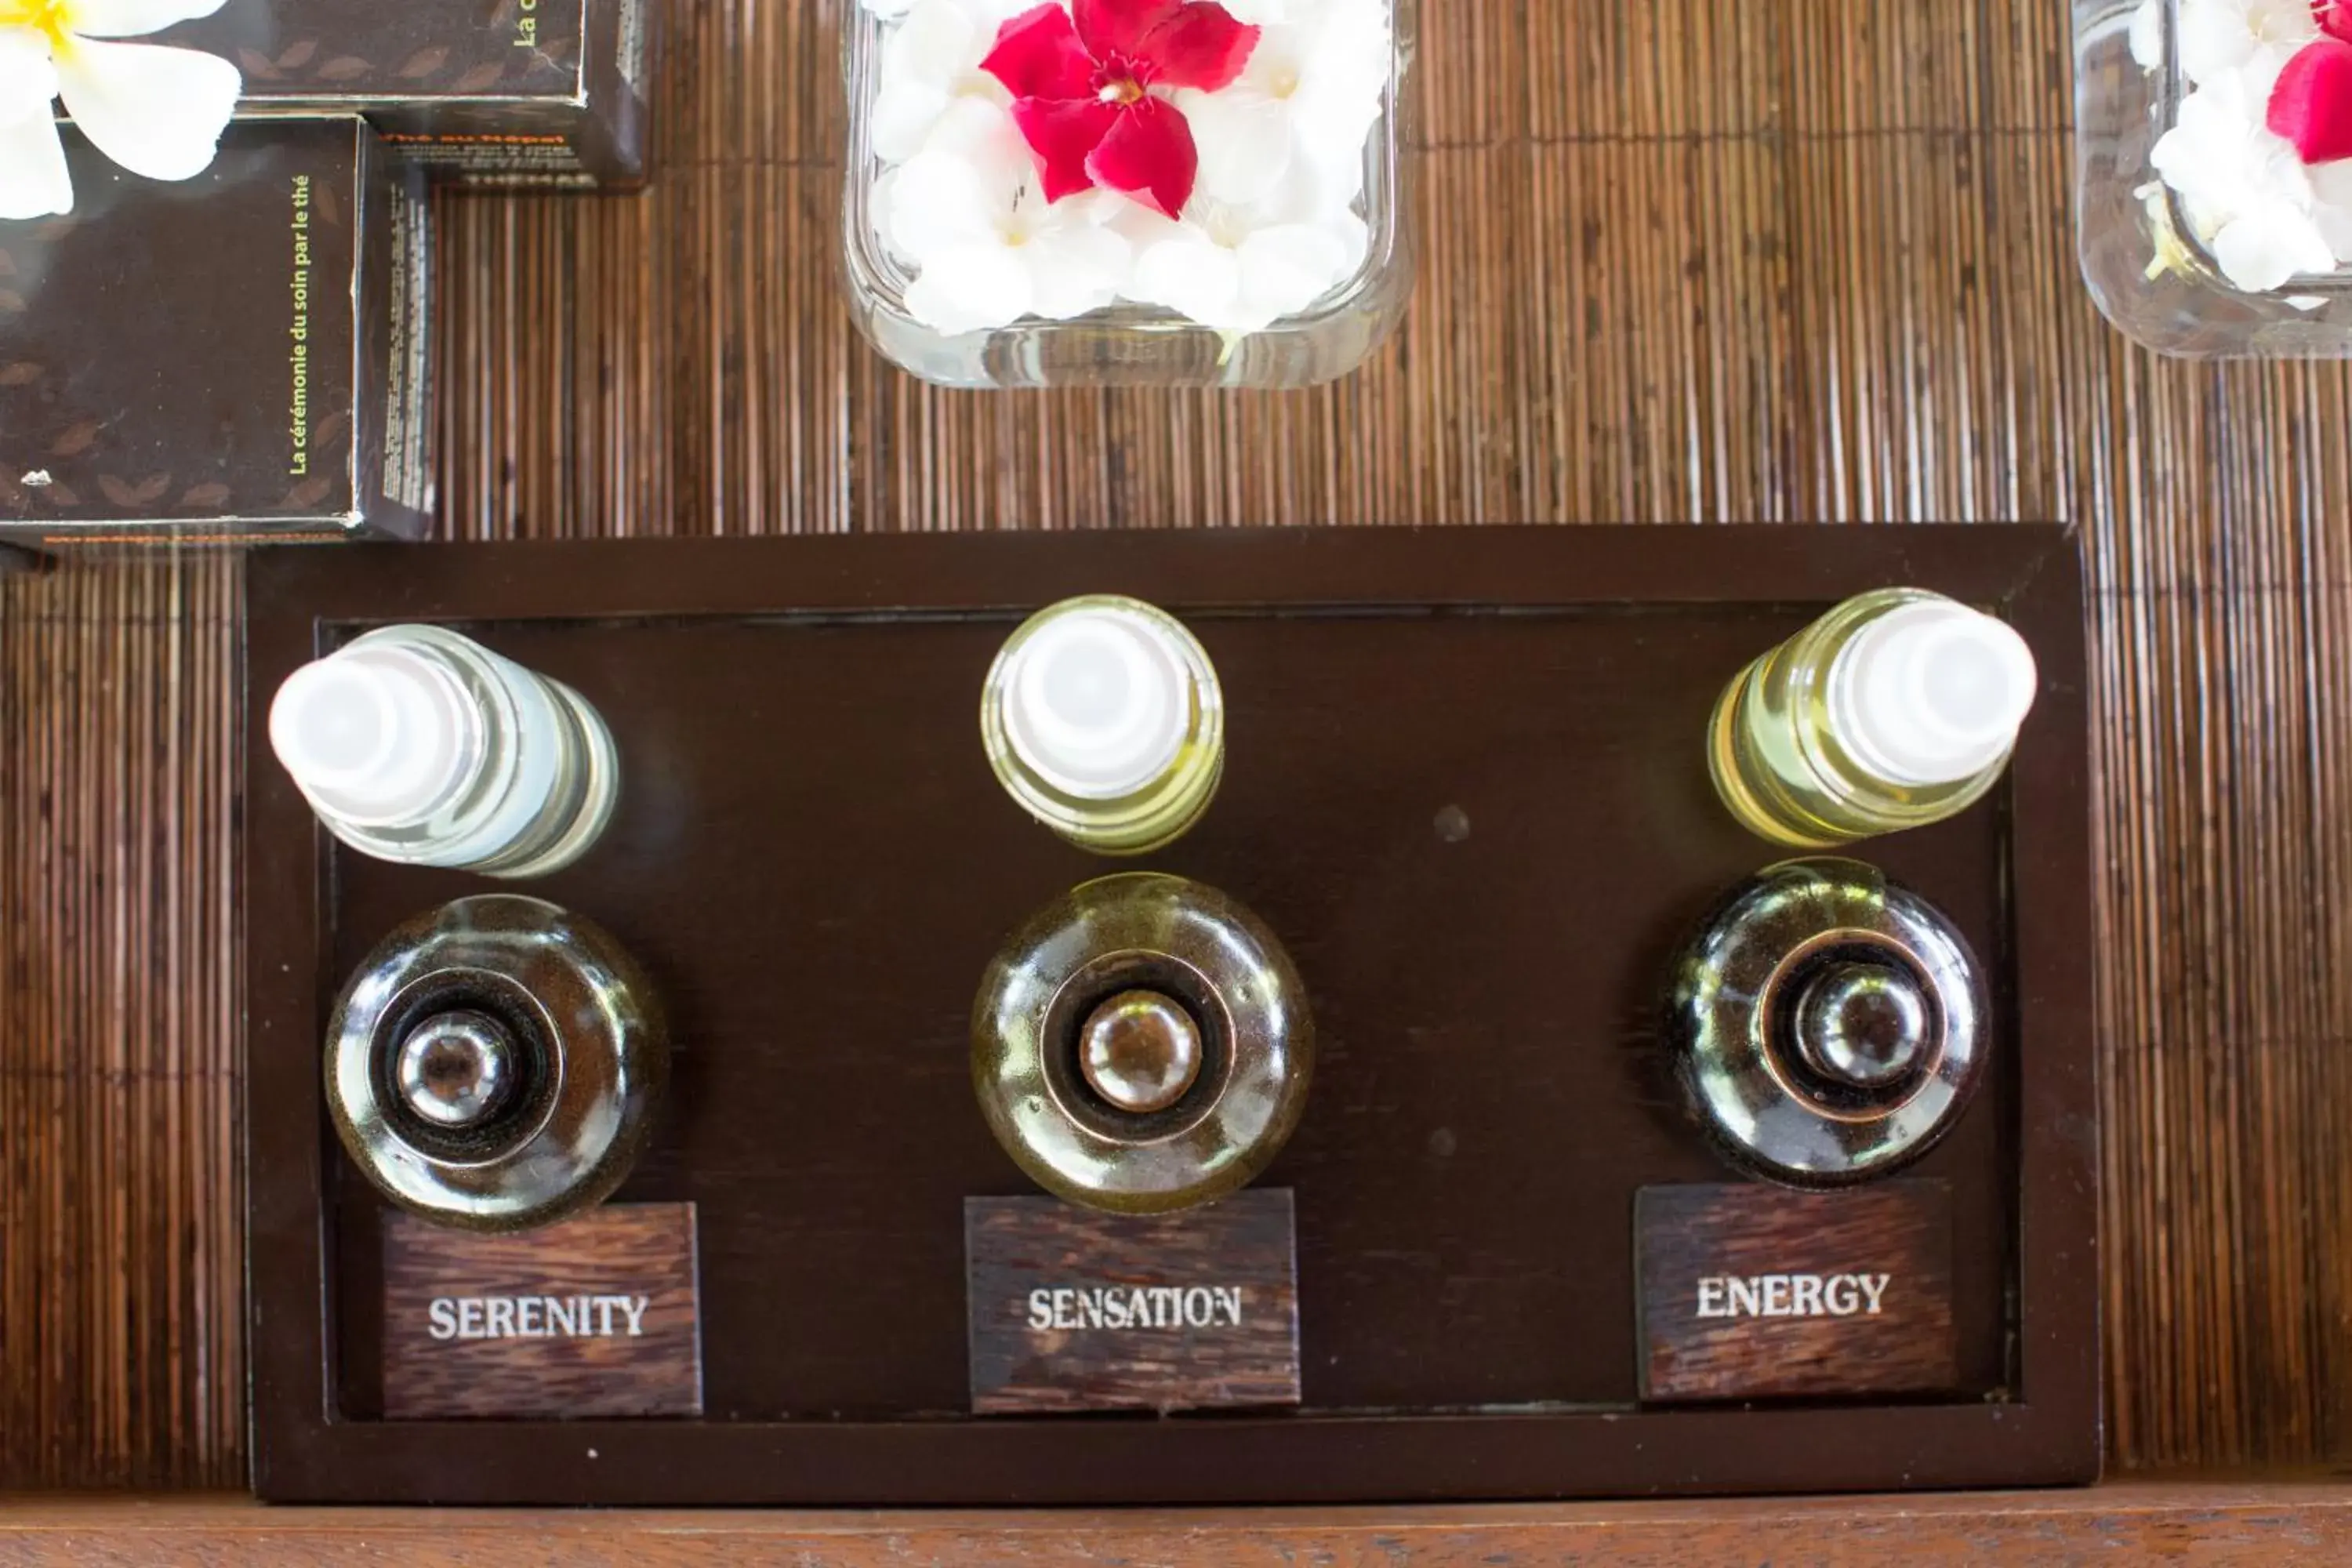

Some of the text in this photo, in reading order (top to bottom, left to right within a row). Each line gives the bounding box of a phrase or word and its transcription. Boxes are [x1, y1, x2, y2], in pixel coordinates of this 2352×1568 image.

[514, 17, 536, 47] La
[289, 175, 311, 474] La cérémonie du soin par le thé
[1028, 1286, 1242, 1330] SENSATION
[1695, 1272, 1891, 1317] ENERGY
[428, 1295, 649, 1340] SERENITY
